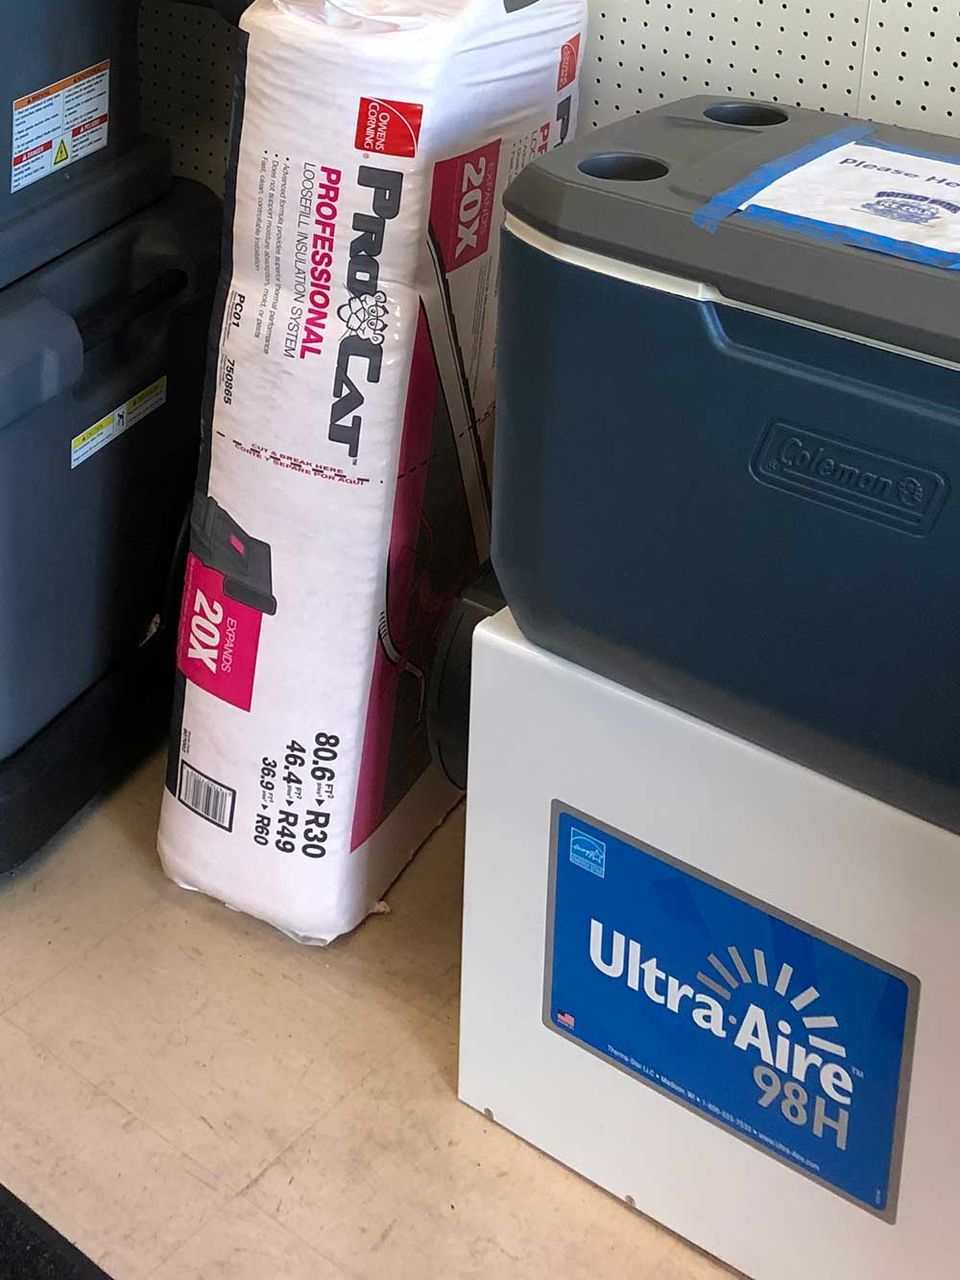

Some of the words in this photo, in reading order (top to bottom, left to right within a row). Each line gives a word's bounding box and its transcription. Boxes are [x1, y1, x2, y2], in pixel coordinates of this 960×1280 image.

[364, 102, 380, 149] CORNING
[375, 111, 390, 151] OWENS
[260, 156, 268, 173] Fast,
[271, 160, 279, 178] Does
[280, 163, 290, 198] Advanced
[839, 158, 920, 178] Please
[267, 192, 275, 219] support
[278, 200, 286, 224] formula
[297, 162, 316, 228] LOOSEFILL
[454, 156, 487, 259] 20X
[264, 220, 272, 249] moisture
[293, 231, 309, 303] INSULATION
[300, 166, 342, 359] PROFESSIONAL
[232, 293, 245, 328] PC01
[259, 310, 264, 318] or
[260, 288, 269, 307] mold,
[271, 283, 281, 310] thermal
[254, 318, 262, 338] pests
[263, 310, 275, 354] performance
[284, 306, 303, 359] SYSTEM
[223, 359, 235, 405] 750865
[234, 444, 261, 459] CORTE
[273, 460, 311, 475] SEPARE
[313, 472, 335, 480] POR
[251, 443, 268, 453] CUT
[280, 453, 313, 467] BREAK
[315, 464, 344, 474] HERE
[777, 436, 893, 496] Coleman
[188, 588, 223, 674] 20X
[221, 617, 237, 673] EXPANDS
[260, 757, 277, 791] 36.9
[282, 739, 306, 785] 46.4
[311, 732, 340, 781] 80.6
[253, 813, 271, 846] R60
[275, 809, 299, 854] R49
[301, 810, 330, 859] R30
[643, 1065, 655, 1077] LLC
[753, 1065, 849, 1151] 98H
